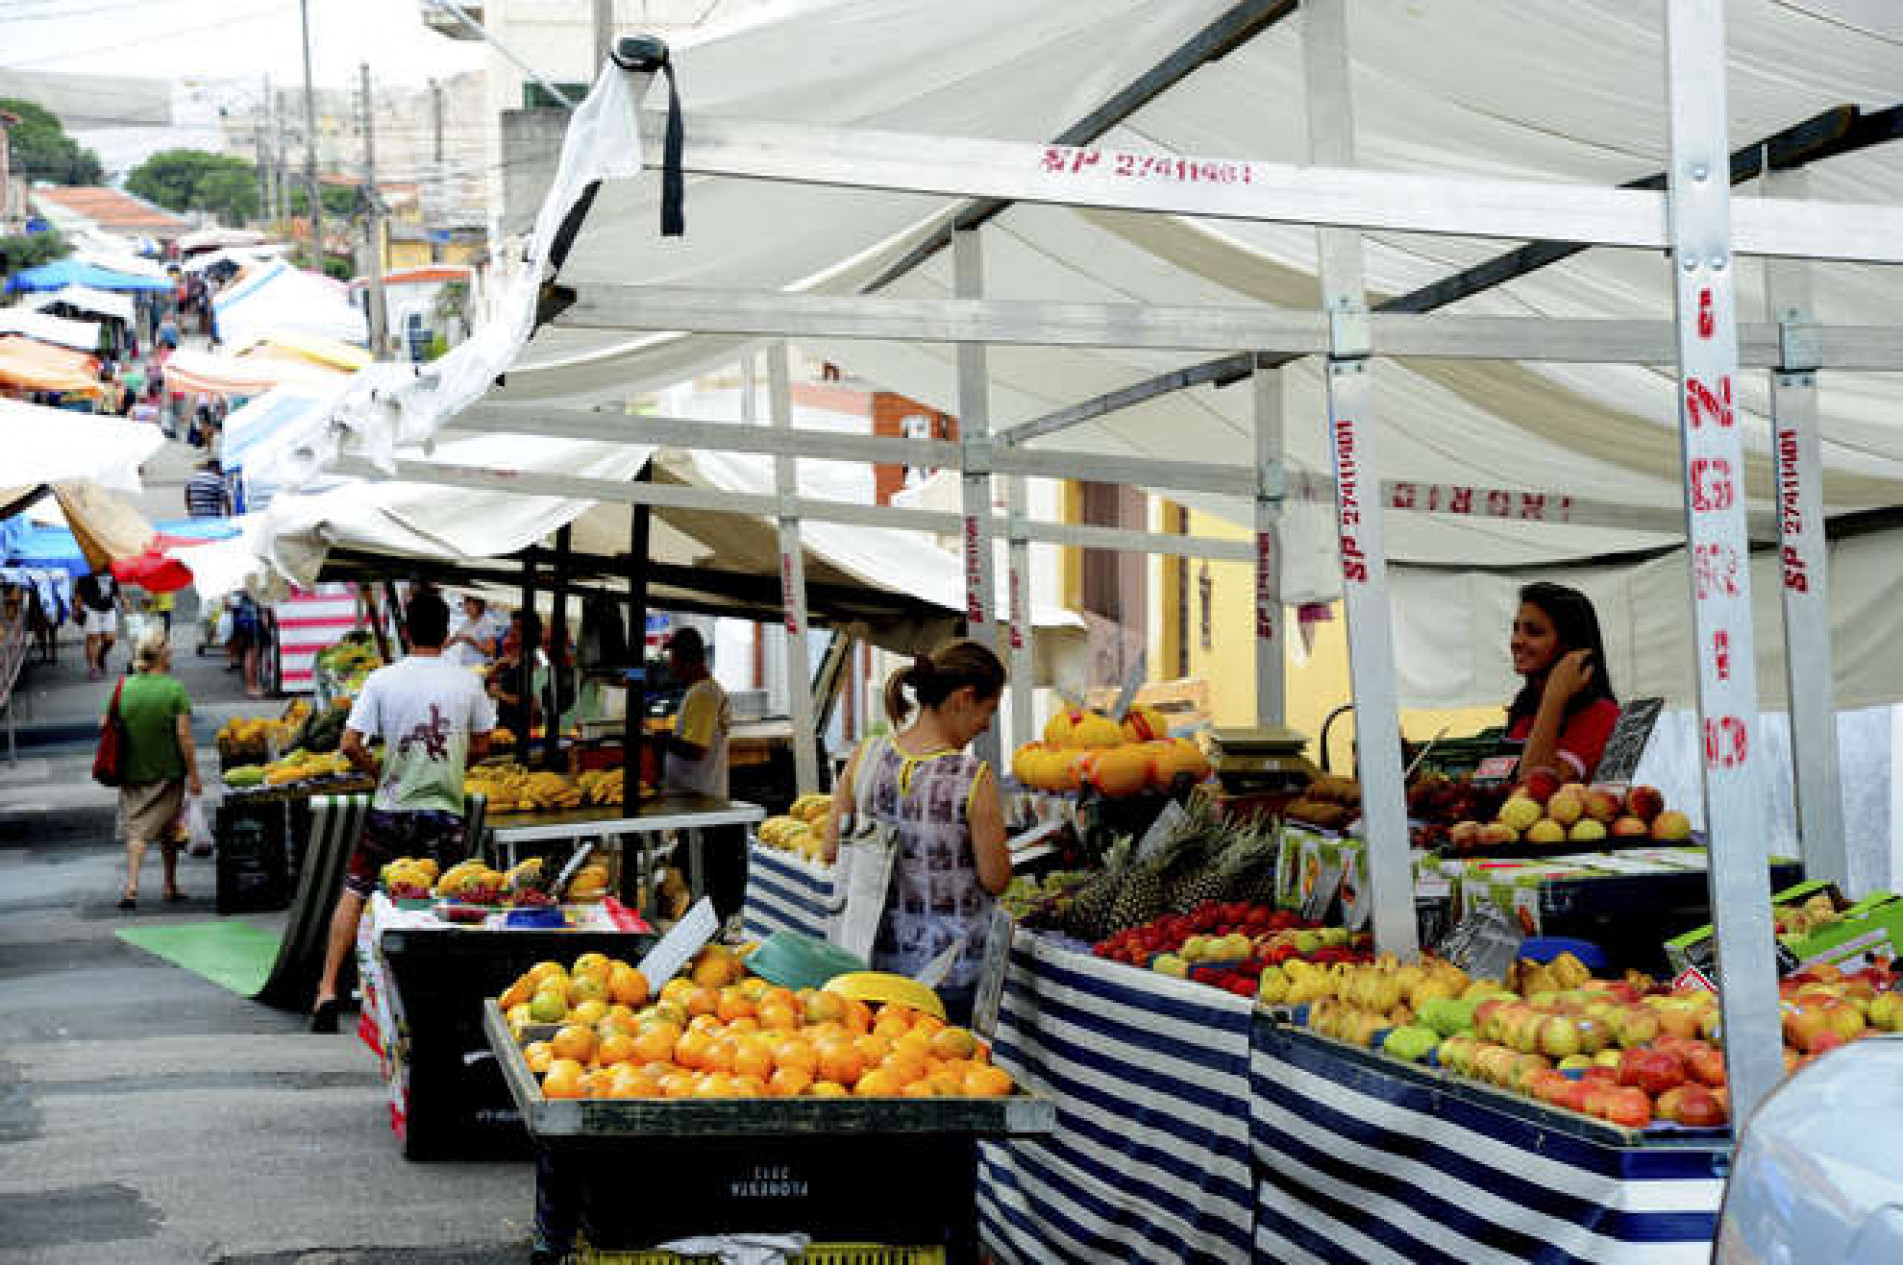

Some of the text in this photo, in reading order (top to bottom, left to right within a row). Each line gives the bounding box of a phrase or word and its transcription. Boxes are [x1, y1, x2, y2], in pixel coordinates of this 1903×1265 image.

[1042, 149, 1100, 174] SP
[1340, 535, 1367, 584] SP
[1781, 547, 1808, 593] SP
